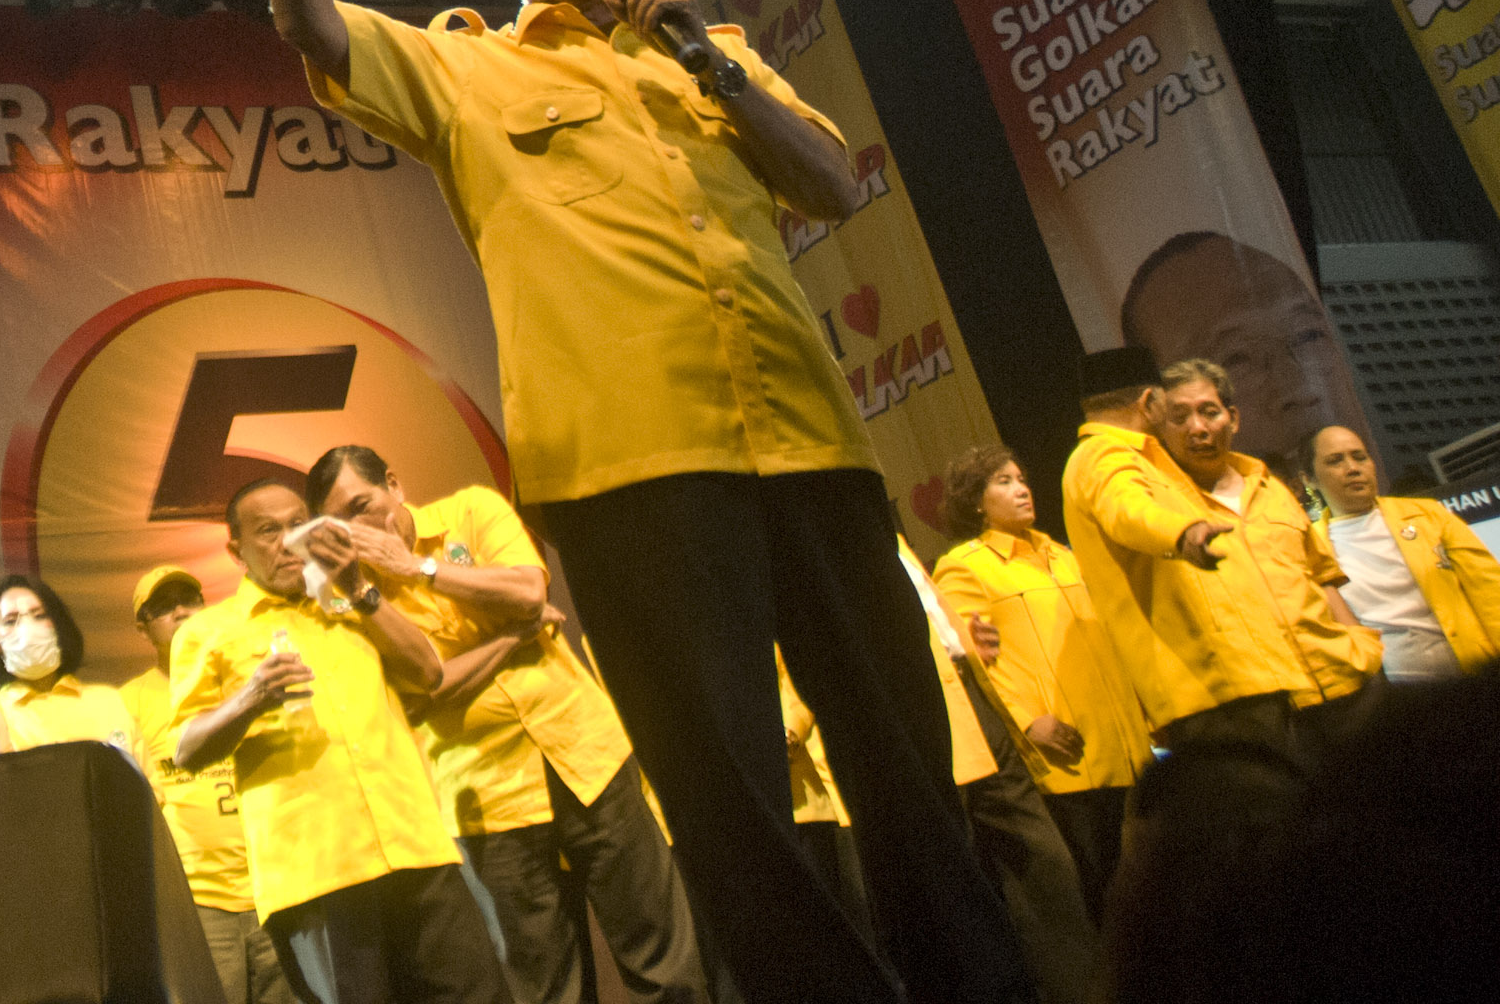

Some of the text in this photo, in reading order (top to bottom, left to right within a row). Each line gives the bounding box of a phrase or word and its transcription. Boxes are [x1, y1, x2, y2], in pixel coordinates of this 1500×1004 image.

[1026, 33, 1162, 142] Suara
[1434, 13, 1500, 83] Sua
[1044, 51, 1226, 190] Rakyat
[1454, 74, 1500, 123] Su
[847, 319, 954, 422] LKAR
[1441, 488, 1492, 512] HAN
